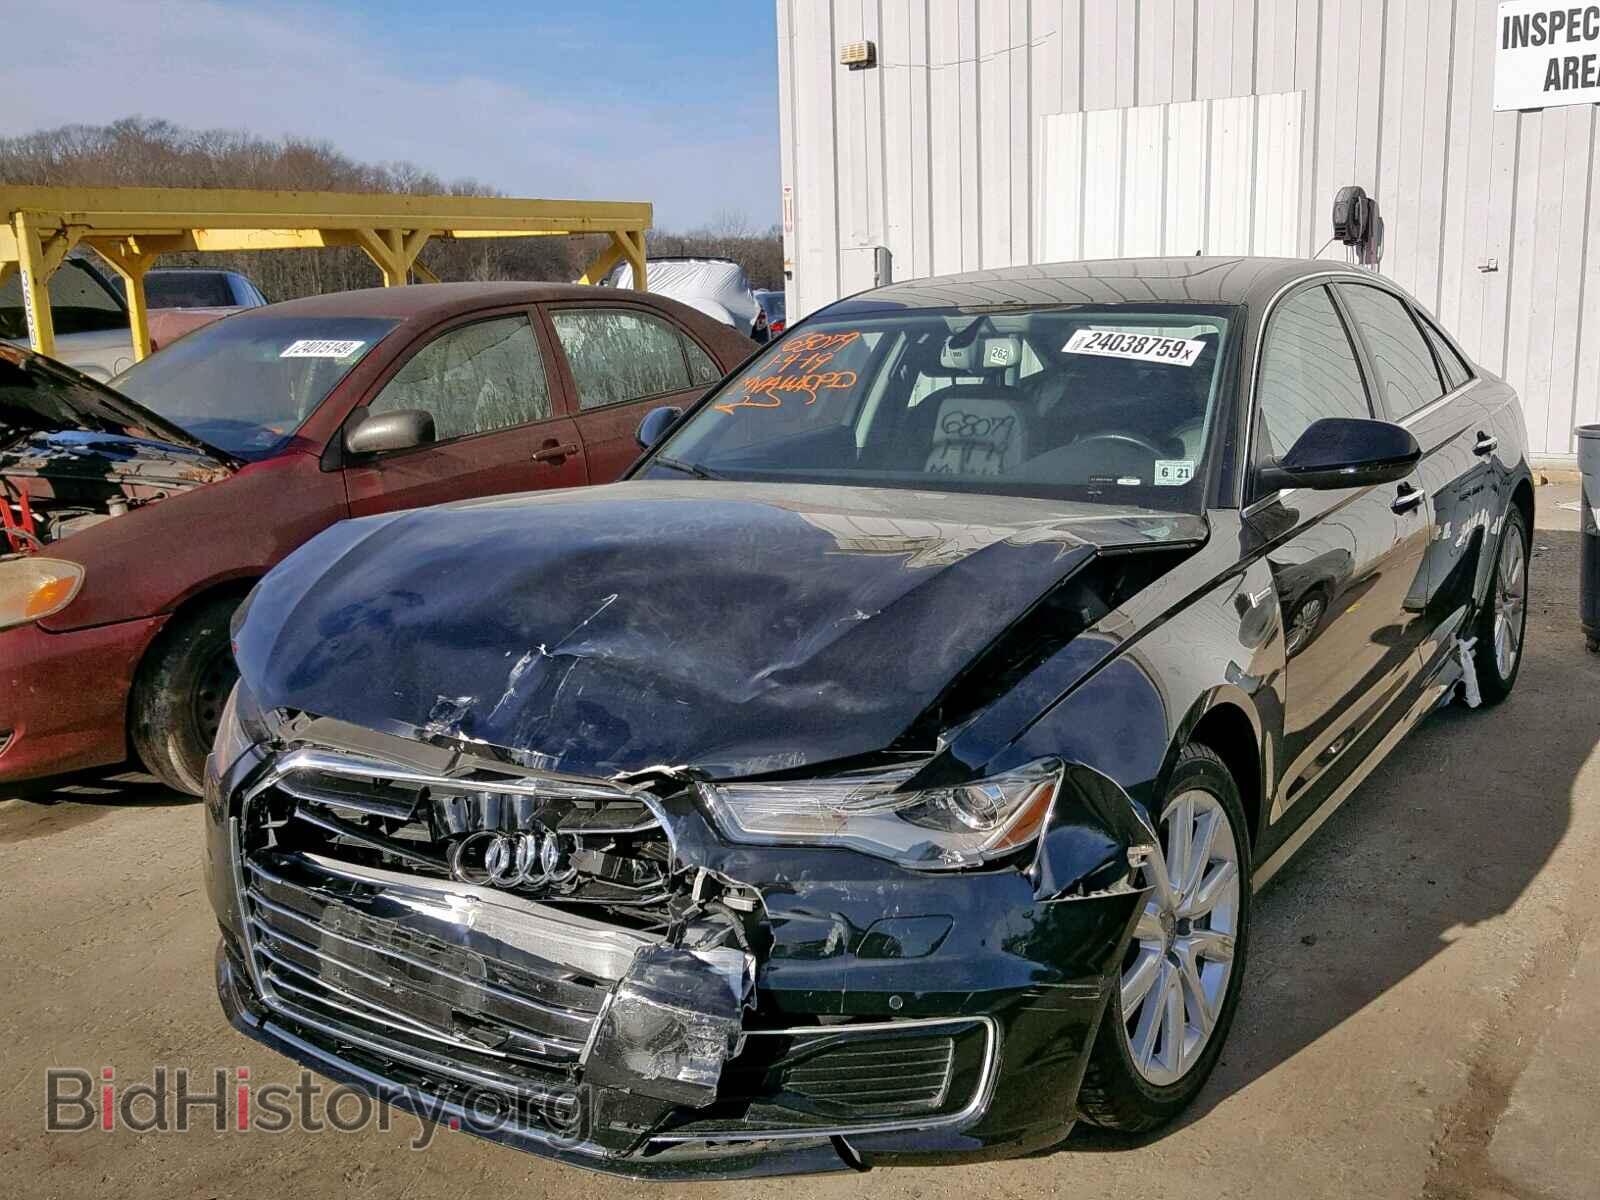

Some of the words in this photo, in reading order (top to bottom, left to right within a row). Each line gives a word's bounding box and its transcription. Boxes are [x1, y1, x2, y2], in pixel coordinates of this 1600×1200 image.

[1502, 6, 1600, 50] INSPEC
[1543, 54, 1600, 92] ARE
[992, 346, 1008, 360] 262
[1161, 467, 1169, 478] 6
[1176, 468, 1190, 479] 21
